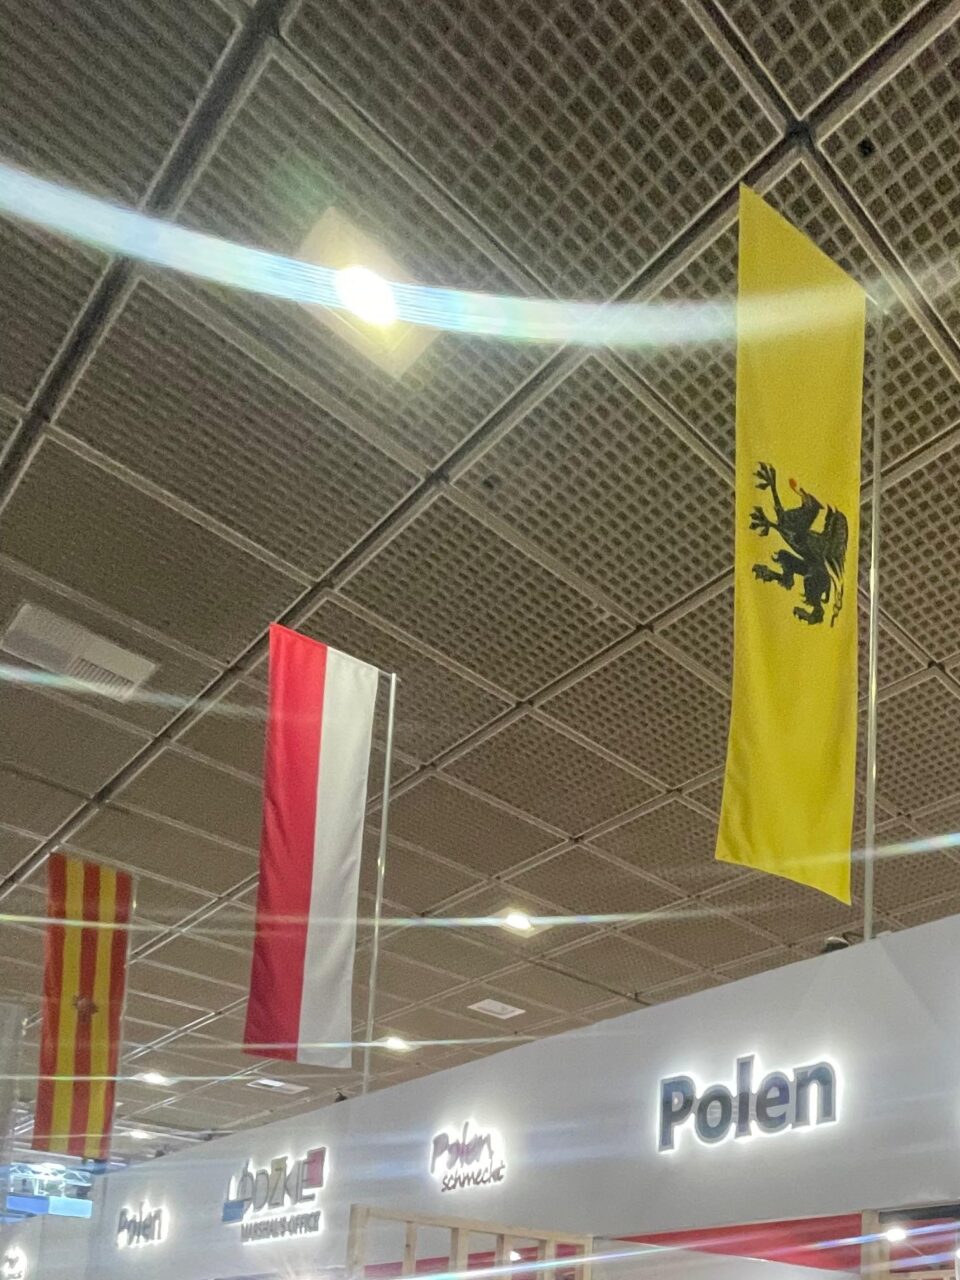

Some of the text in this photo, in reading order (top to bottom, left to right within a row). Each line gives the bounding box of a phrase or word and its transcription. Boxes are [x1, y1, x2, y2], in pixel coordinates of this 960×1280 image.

[658, 1054, 837, 1152] Polen
[430, 1121, 494, 1174] Polen
[441, 1153, 506, 1192] schmeckt
